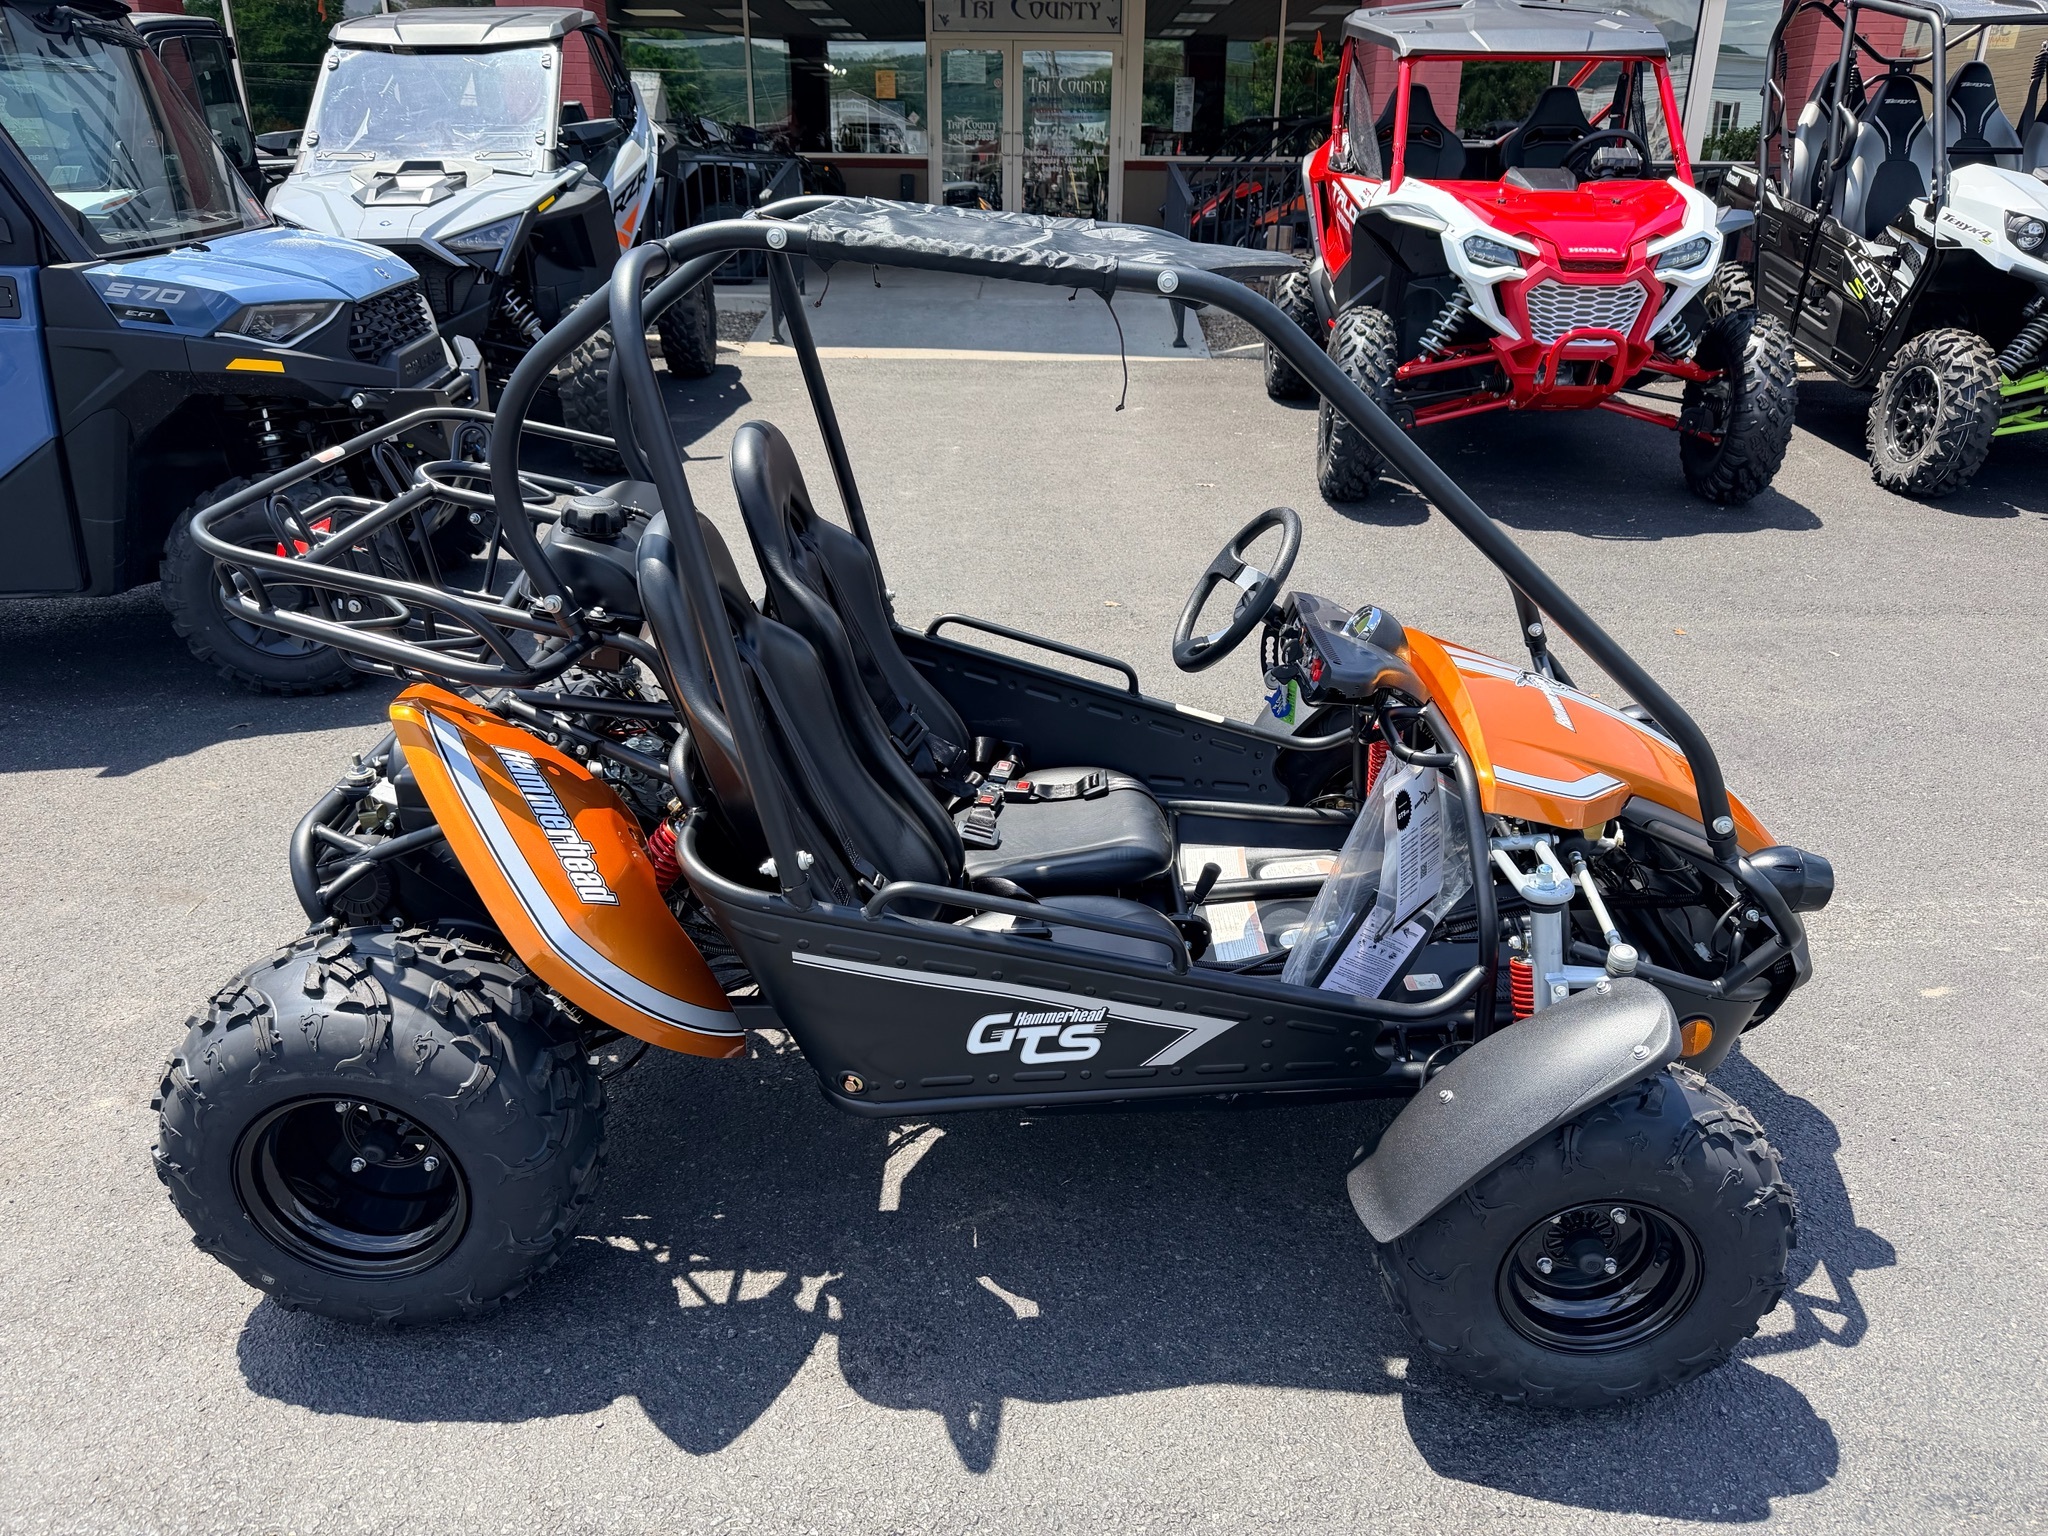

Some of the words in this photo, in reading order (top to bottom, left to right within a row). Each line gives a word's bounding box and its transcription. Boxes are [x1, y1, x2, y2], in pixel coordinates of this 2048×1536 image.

[613, 163, 648, 219] RZR
[1331, 180, 1360, 226] TALO
[1567, 246, 1618, 254] HONDA
[103, 282, 187, 304] 570
[125, 309, 156, 319] EFI
[490, 744, 621, 906] Hammerhead
[1013, 1006, 1109, 1027] Hammerhead
[966, 1012, 1109, 1065] GTS
